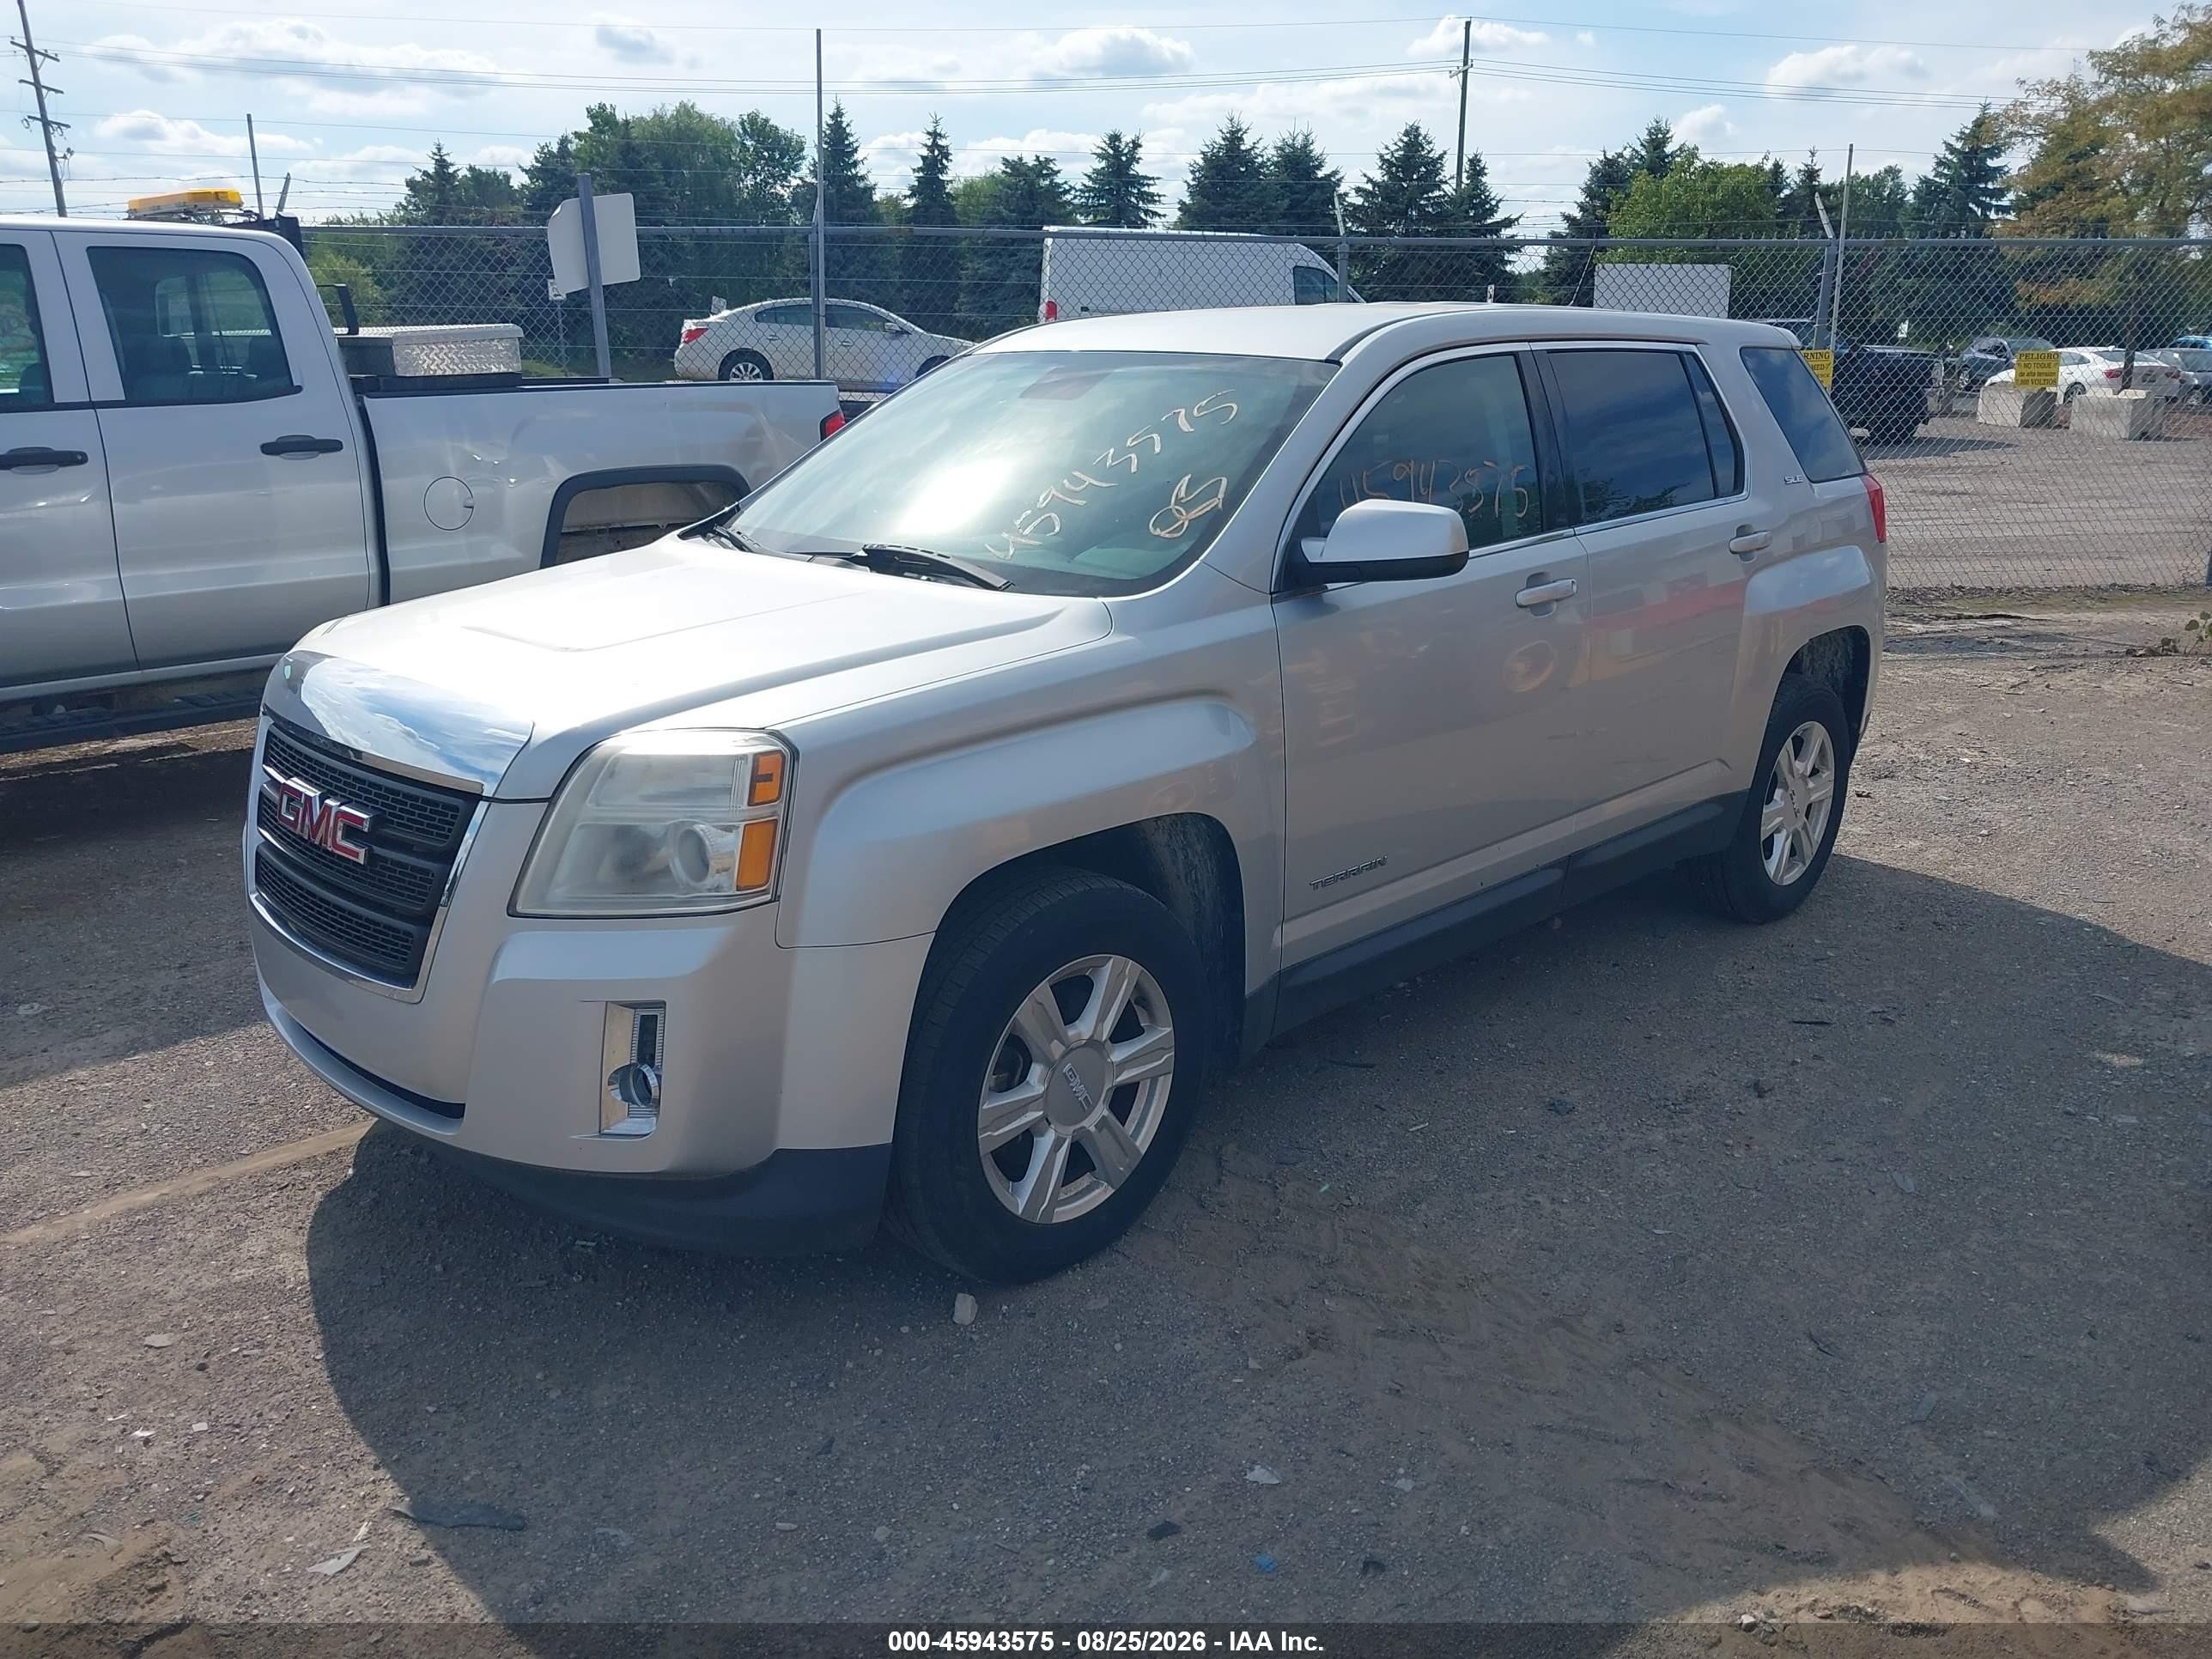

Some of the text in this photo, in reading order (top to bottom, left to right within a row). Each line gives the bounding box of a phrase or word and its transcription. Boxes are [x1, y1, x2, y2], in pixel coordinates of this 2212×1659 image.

[985, 389, 1238, 560] 45943575
[1784, 474, 1803, 485] SLE
[277, 777, 370, 866] GMC
[1310, 854, 1388, 890] TERRAIN
[1063, 1062, 1093, 1110] GMC
